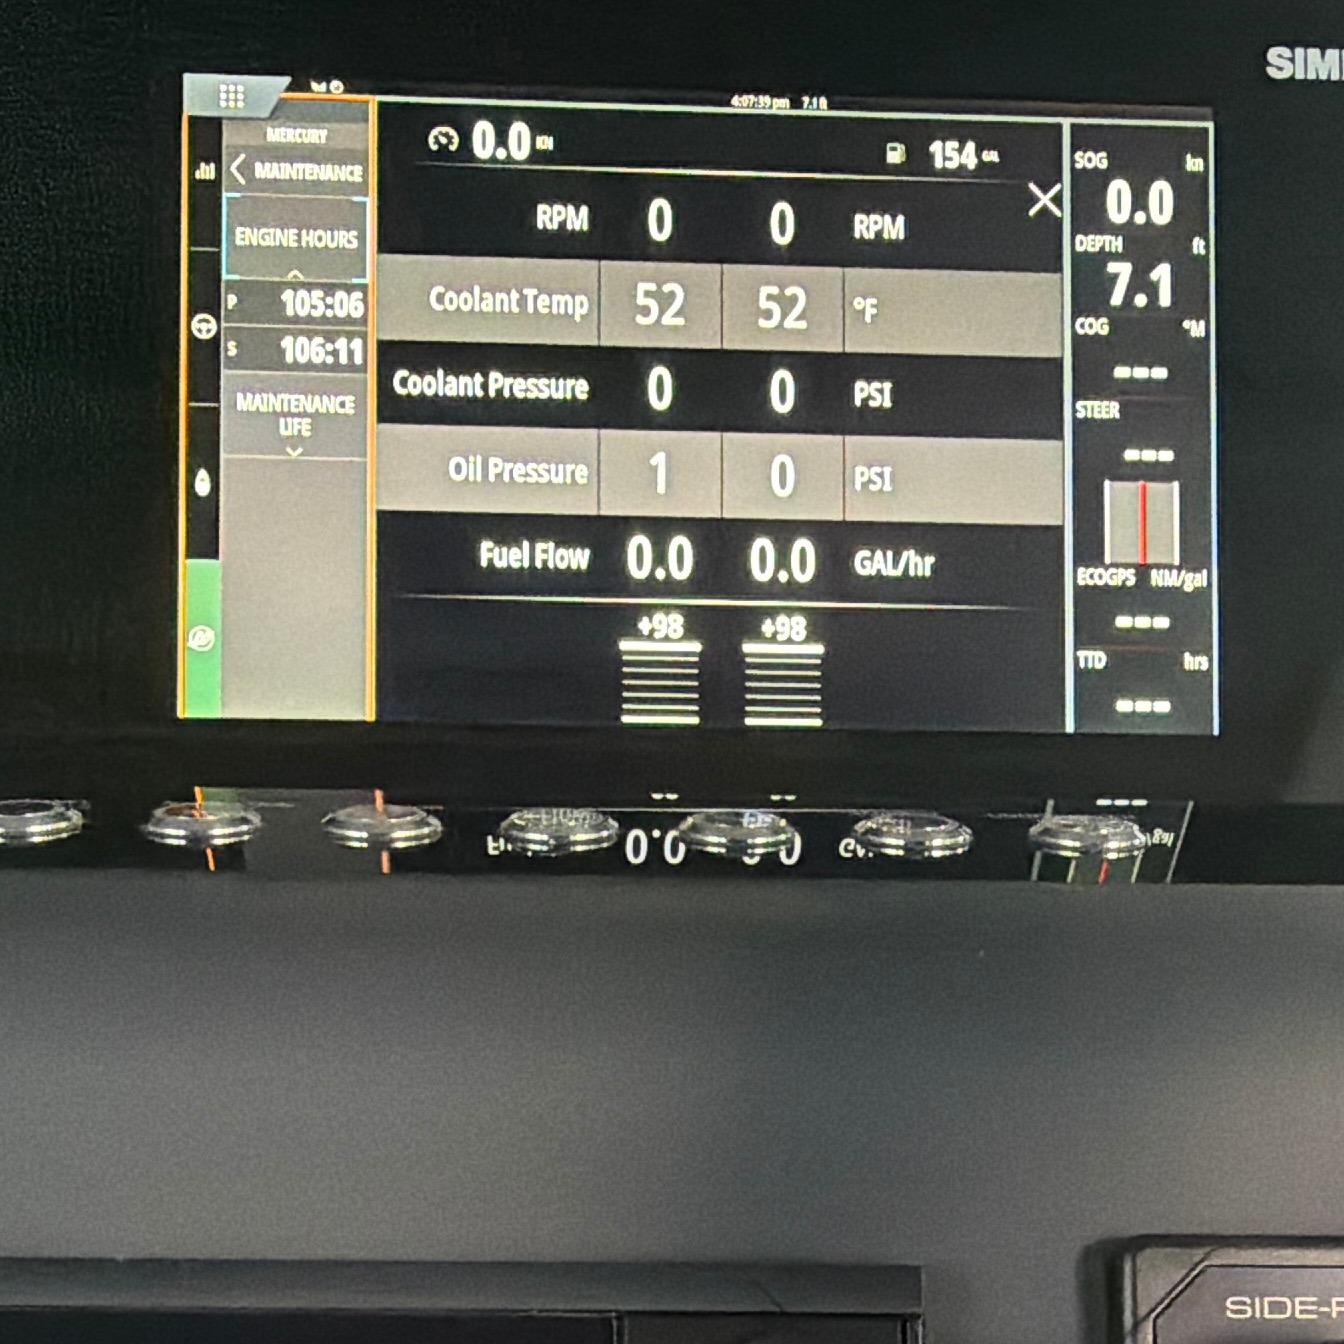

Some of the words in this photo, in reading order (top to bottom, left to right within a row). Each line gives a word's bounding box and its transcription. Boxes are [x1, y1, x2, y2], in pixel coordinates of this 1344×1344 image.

[266, 127, 327, 144] MERCURY
[472, 120, 531, 160] 0.0
[929, 140, 978, 170] 154
[1074, 151, 1108, 170] SOG
[1186, 153, 1204, 172] kn
[255, 164, 363, 183] MAINTENANCE
[1106, 178, 1174, 226] 0.0
[536, 204, 588, 231] RPM
[648, 198, 673, 242] 0
[770, 200, 795, 245] 0
[854, 213, 905, 241] RPM
[235, 227, 298, 247] ENGINE
[302, 230, 358, 250] HOURS
[1075, 234, 1123, 254] DEPTH
[1192, 236, 1206, 255] ft
[1106, 261, 1173, 308] 7.1
[227, 294, 238, 310] P
[281, 289, 364, 318] 105:06
[429, 285, 520, 313] Coolant
[522, 288, 589, 322] Temp
[635, 282, 686, 326] 52
[757, 285, 808, 330] 52
[1075, 317, 1109, 336] COG
[227, 340, 237, 357] S
[281, 336, 363, 365] 106:11
[236, 393, 355, 414] MAINTENANCE
[393, 369, 485, 397] Coolant
[488, 372, 589, 400] Pressure
[648, 366, 673, 410] 0
[770, 368, 795, 414] 0
[854, 381, 892, 408] PSI
[1075, 400, 1120, 420] STEER
[279, 419, 311, 437] LIFE
[448, 455, 483, 482] Oil
[488, 457, 588, 486] Pressure
[649, 450, 667, 495] 1
[770, 453, 795, 499] 0
[854, 465, 893, 492] PSI
[480, 541, 530, 570] Fuel
[534, 541, 590, 570] Flow
[626, 534, 694, 581] 0.0
[749, 536, 817, 583] 0.0
[854, 549, 936, 578] GAL/hr
[1077, 568, 1136, 587] ECOGPS
[1150, 569, 1208, 592] NM/gal
[637, 612, 684, 640] +98
[761, 615, 807, 642] +98
[1077, 651, 1107, 670] TTD
[1184, 652, 1209, 671] hrs
